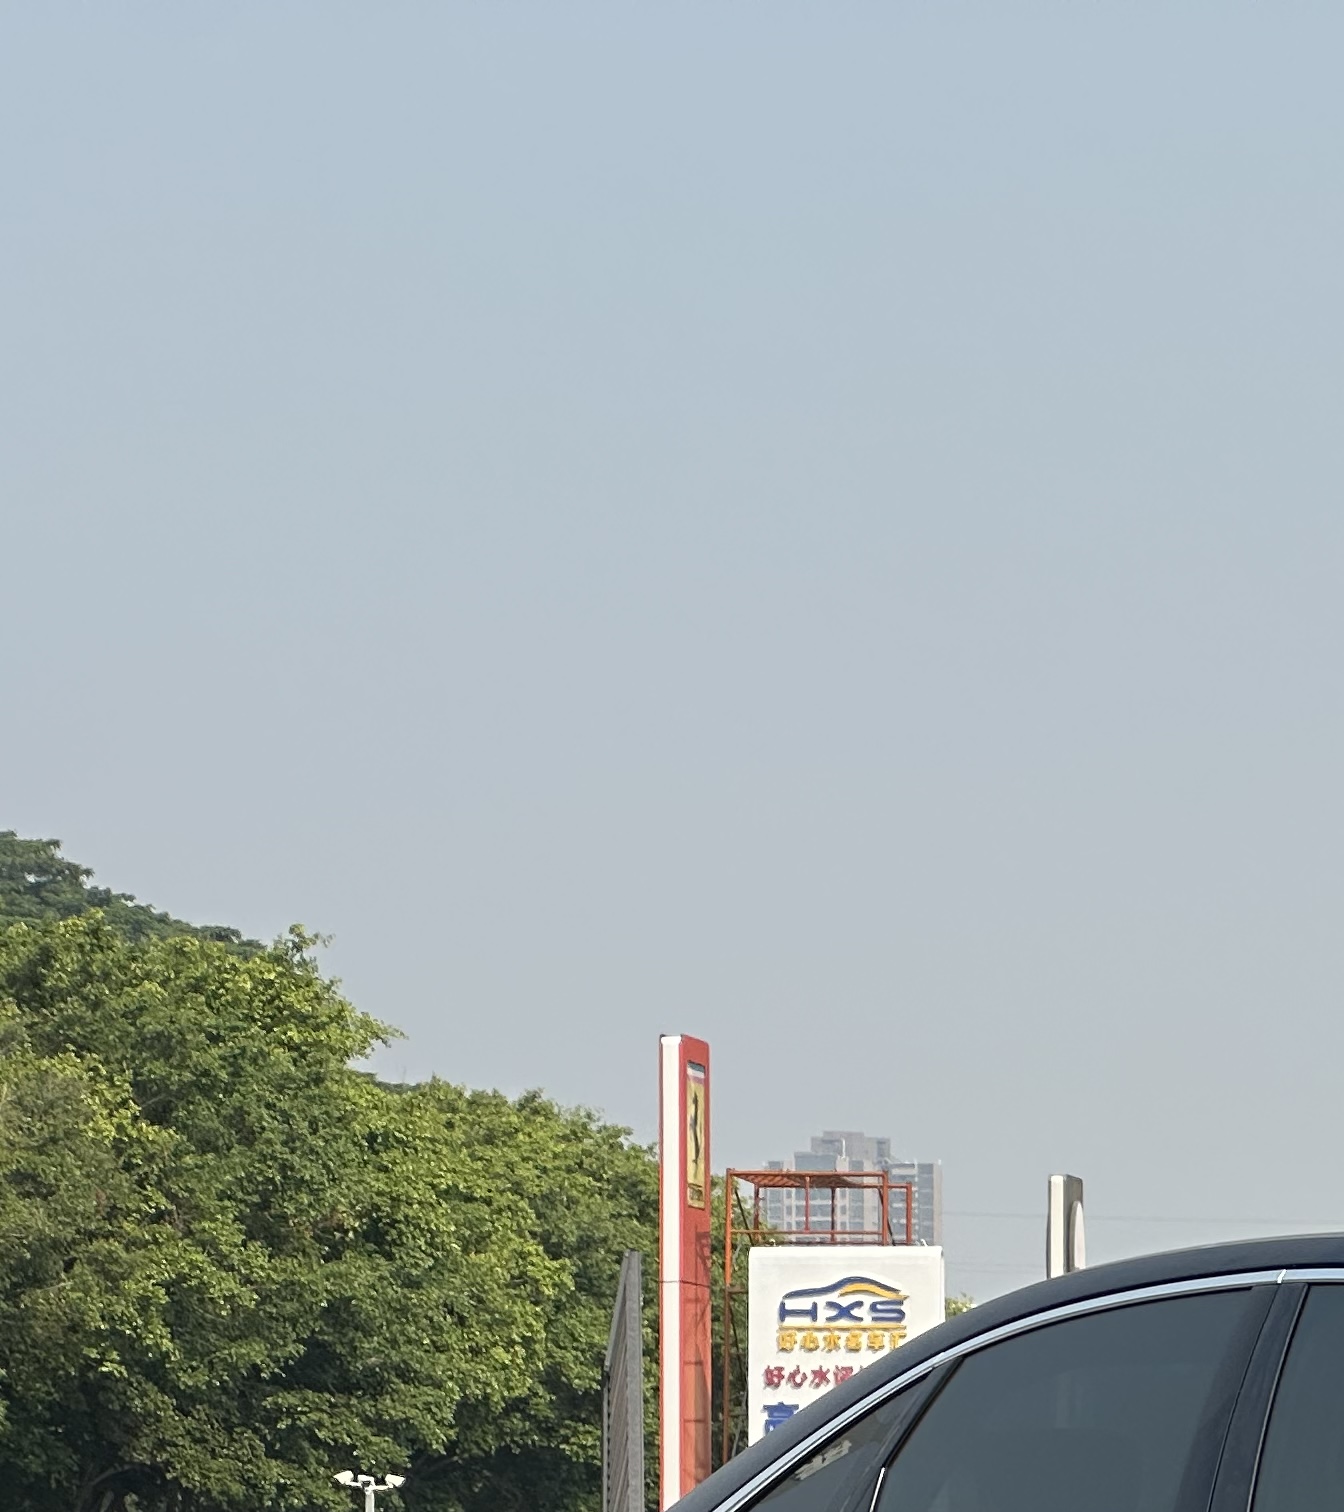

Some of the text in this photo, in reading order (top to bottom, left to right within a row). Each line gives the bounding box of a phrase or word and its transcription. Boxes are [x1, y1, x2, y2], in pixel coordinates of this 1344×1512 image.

[778, 1300, 906, 1323] HXS
[762, 1364, 864, 1389] 好心水
